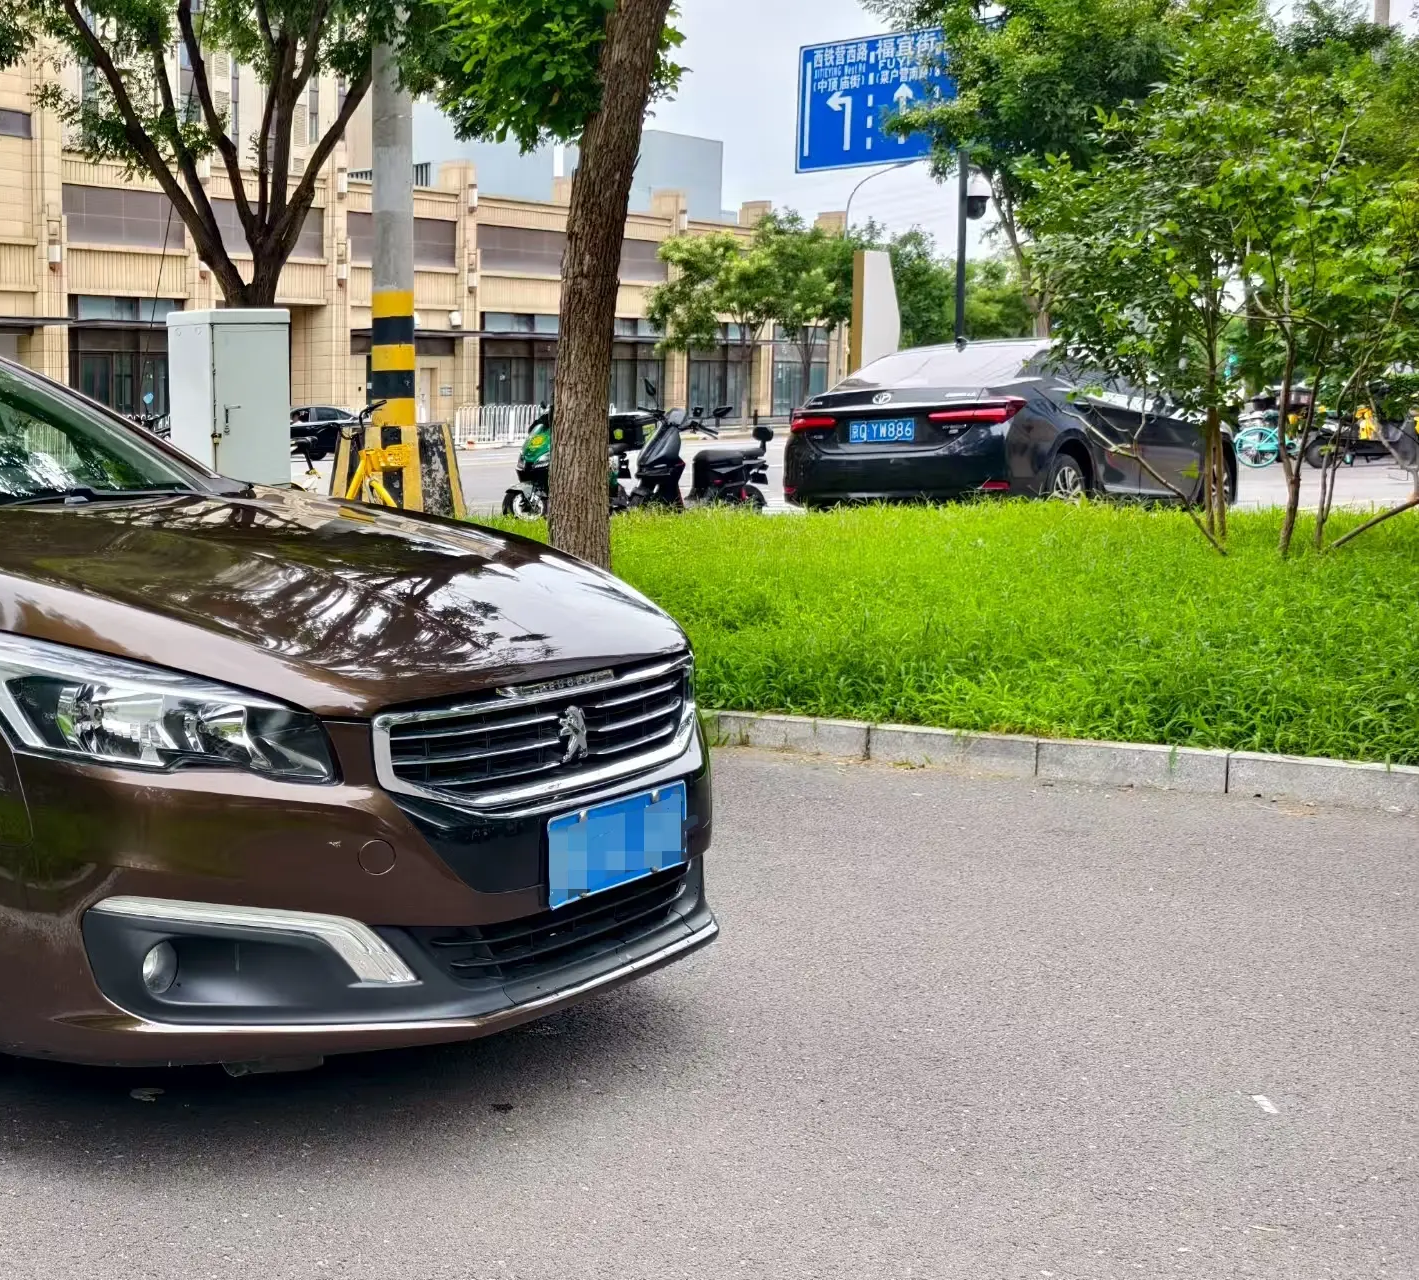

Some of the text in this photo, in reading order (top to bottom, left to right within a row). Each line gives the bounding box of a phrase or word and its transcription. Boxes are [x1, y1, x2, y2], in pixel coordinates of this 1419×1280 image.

[813, 43, 868, 68] 西铁营西路
[876, 33, 937, 60] 福宜街
